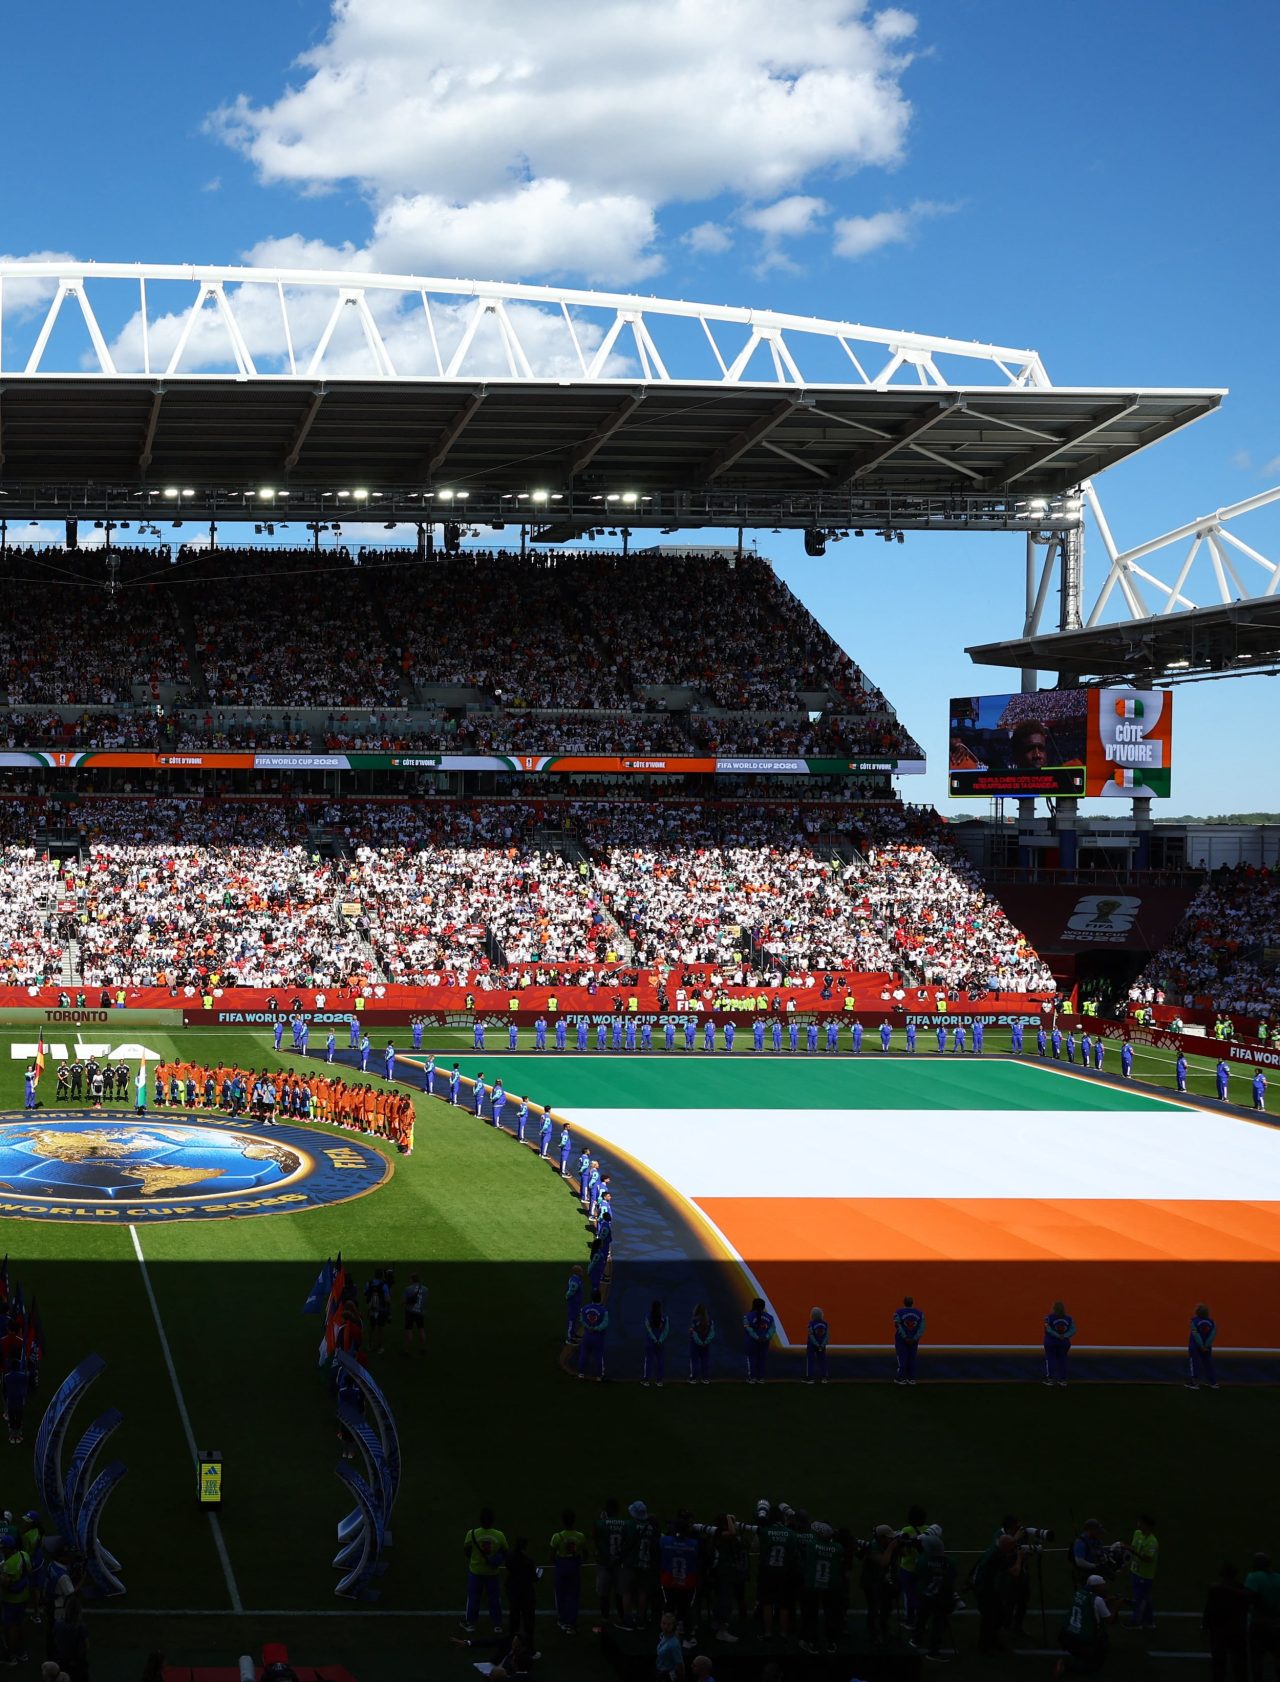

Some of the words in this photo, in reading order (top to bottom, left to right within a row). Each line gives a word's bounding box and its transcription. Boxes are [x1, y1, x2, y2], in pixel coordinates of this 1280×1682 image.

[1115, 722, 1143, 742] CÔTE
[1105, 745, 1152, 762] D'IVOIRE
[677, 1000, 704, 1011] FIA
[45, 1010, 108, 1022] TORONTO
[219, 1012, 243, 1022] FIFA
[245, 1013, 287, 1023] WORLD
[289, 1013, 312, 1023] CP
[313, 1013, 353, 1023] 2026
[566, 1014, 590, 1024] FIFA
[635, 1015, 658, 1024] CUP
[906, 1015, 930, 1025] FIFA
[932, 1015, 972, 1025] WORLD
[1230, 1047, 1252, 1059] FIFA
[197, 1117, 254, 1128] FIFA
[323, 1147, 368, 1169] FIFA
[127, 1207, 195, 1216] CUP
[201, 1193, 309, 1212] 2026
